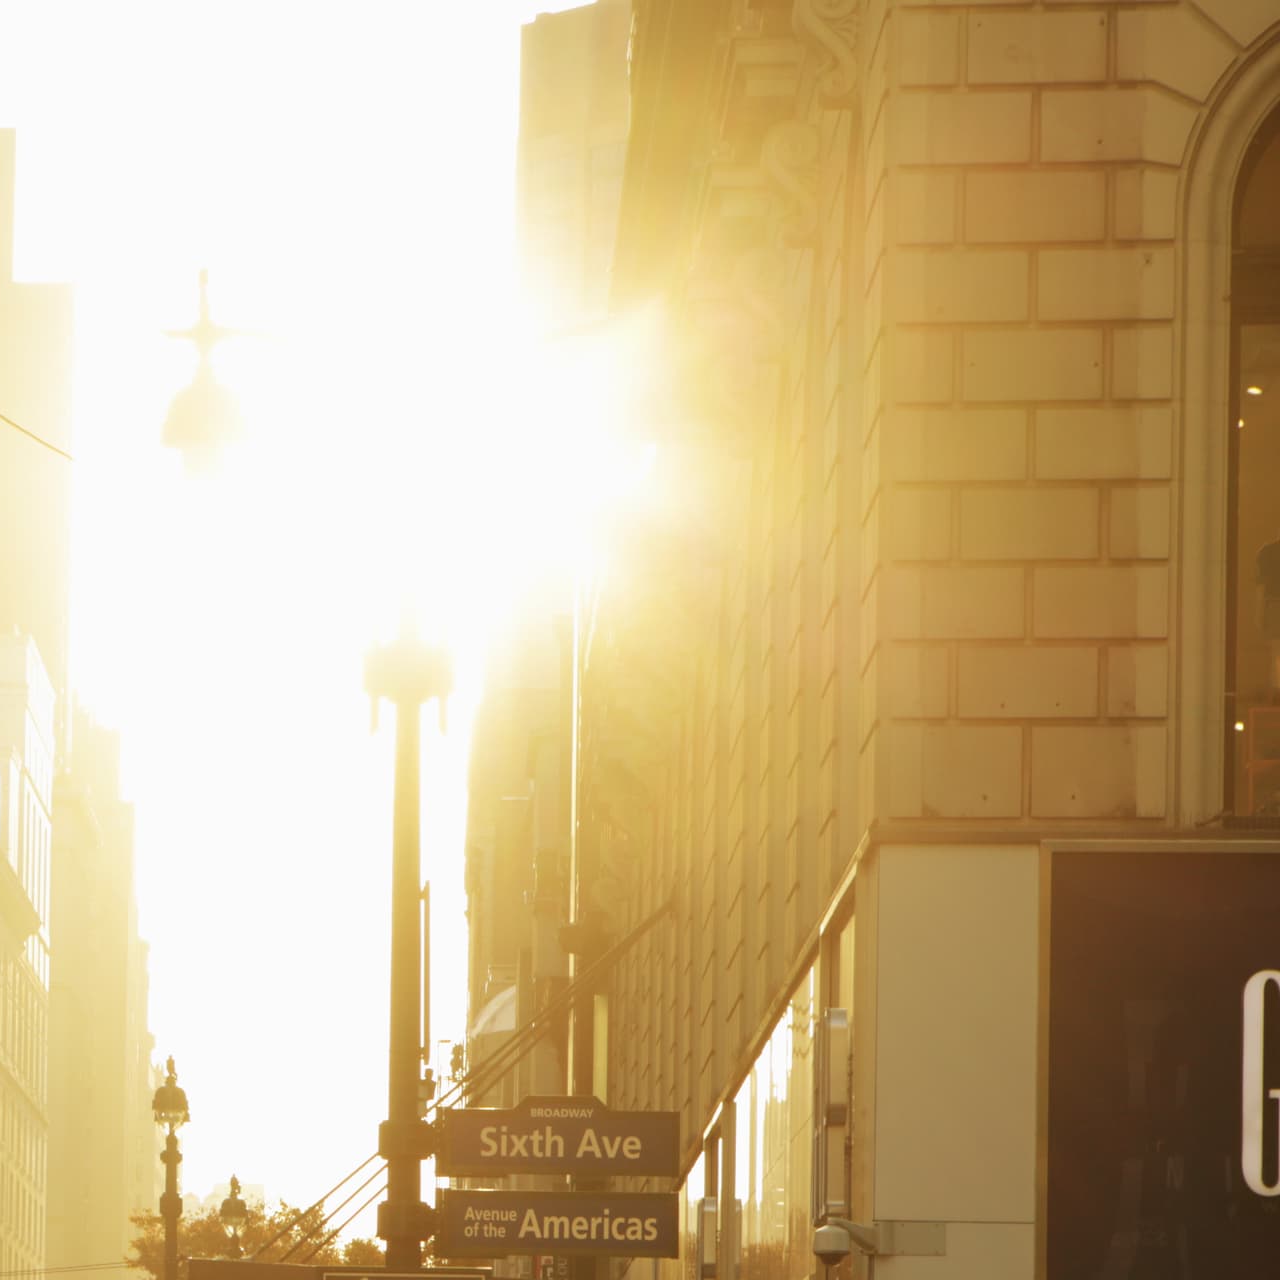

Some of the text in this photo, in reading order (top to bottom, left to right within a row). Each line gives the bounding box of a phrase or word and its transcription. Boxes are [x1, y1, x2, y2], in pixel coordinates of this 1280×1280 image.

[530, 1107, 594, 1118] BROADWAY
[479, 1126, 642, 1159] Sixth Ave
[464, 1206, 517, 1222] Avenue
[464, 1223, 507, 1238] of the
[518, 1209, 658, 1242] Americas
